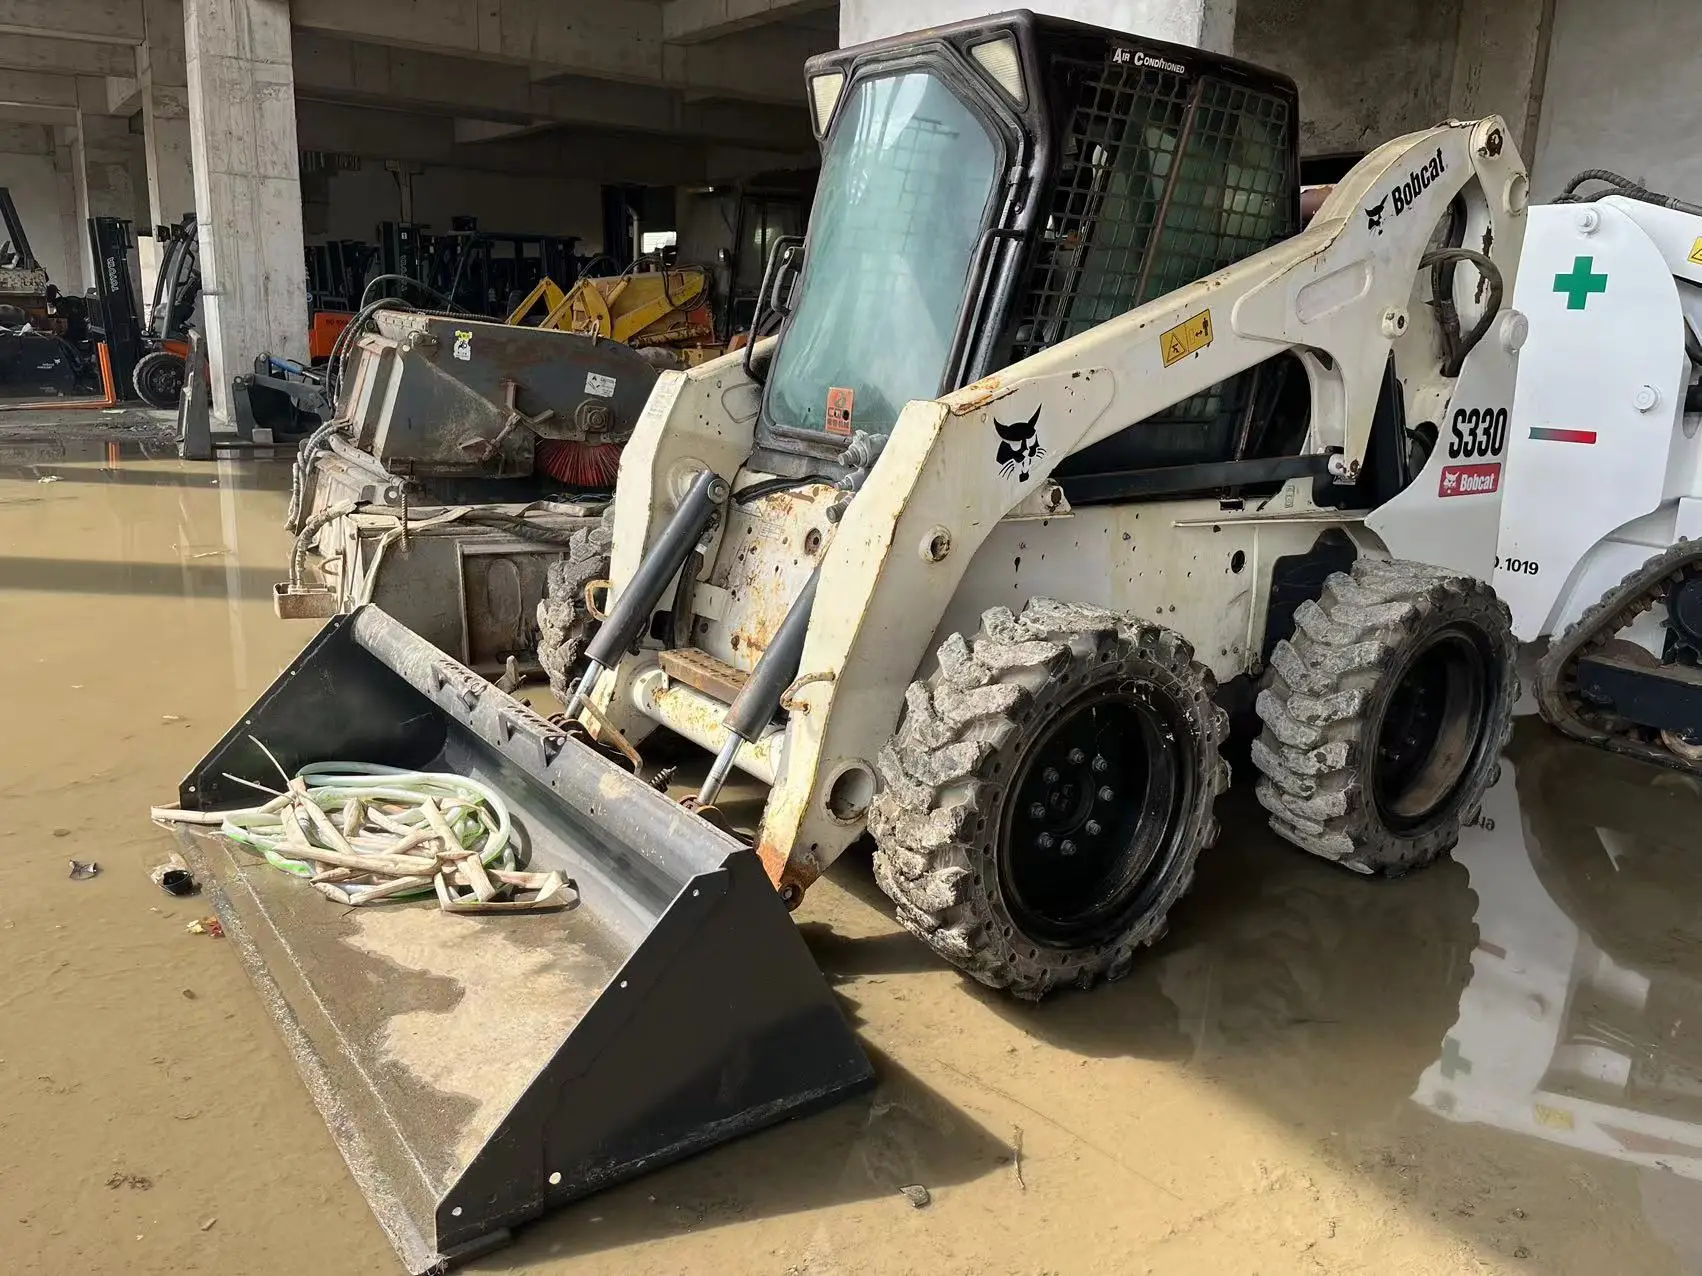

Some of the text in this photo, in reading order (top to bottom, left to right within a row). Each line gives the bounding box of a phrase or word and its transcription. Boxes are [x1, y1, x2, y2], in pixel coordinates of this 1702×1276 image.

[1113, 48, 1185, 74] AIR CONDITIONED
[1391, 147, 1445, 216] Bobcat
[1448, 407, 1508, 459] S330
[1459, 473, 1495, 492] Bobcat
